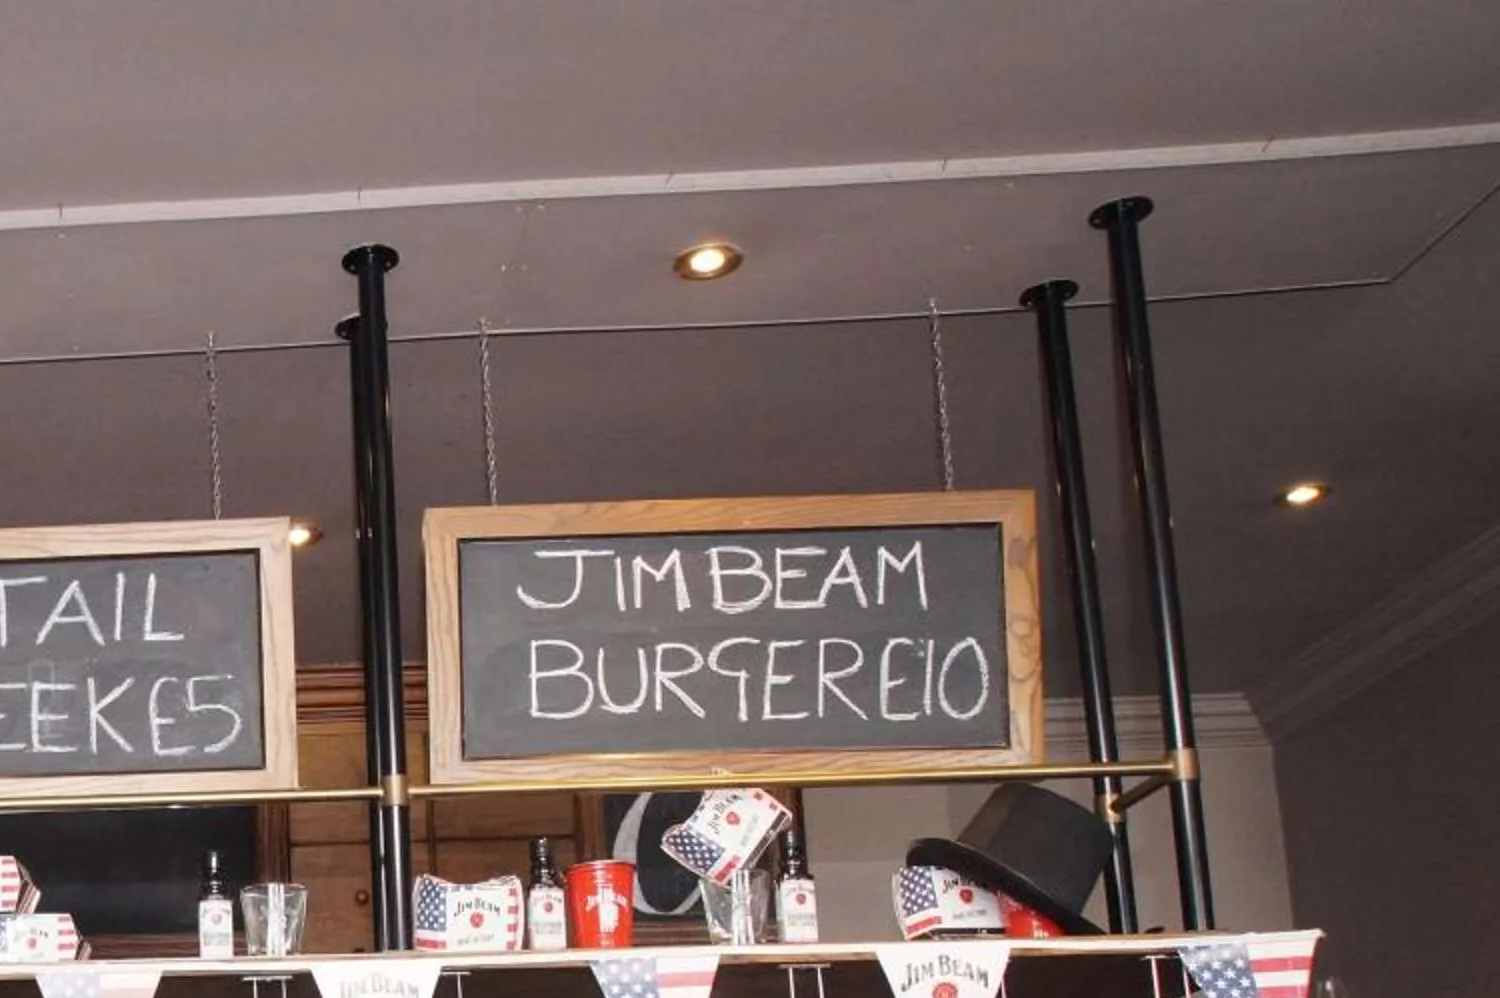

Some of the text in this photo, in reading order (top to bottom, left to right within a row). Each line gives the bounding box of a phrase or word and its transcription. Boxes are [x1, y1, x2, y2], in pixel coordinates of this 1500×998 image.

[516, 541, 928, 614] JIM BEAM
[528, 637, 868, 722] BURGER
[901, 954, 988, 992] JIM BEAM
